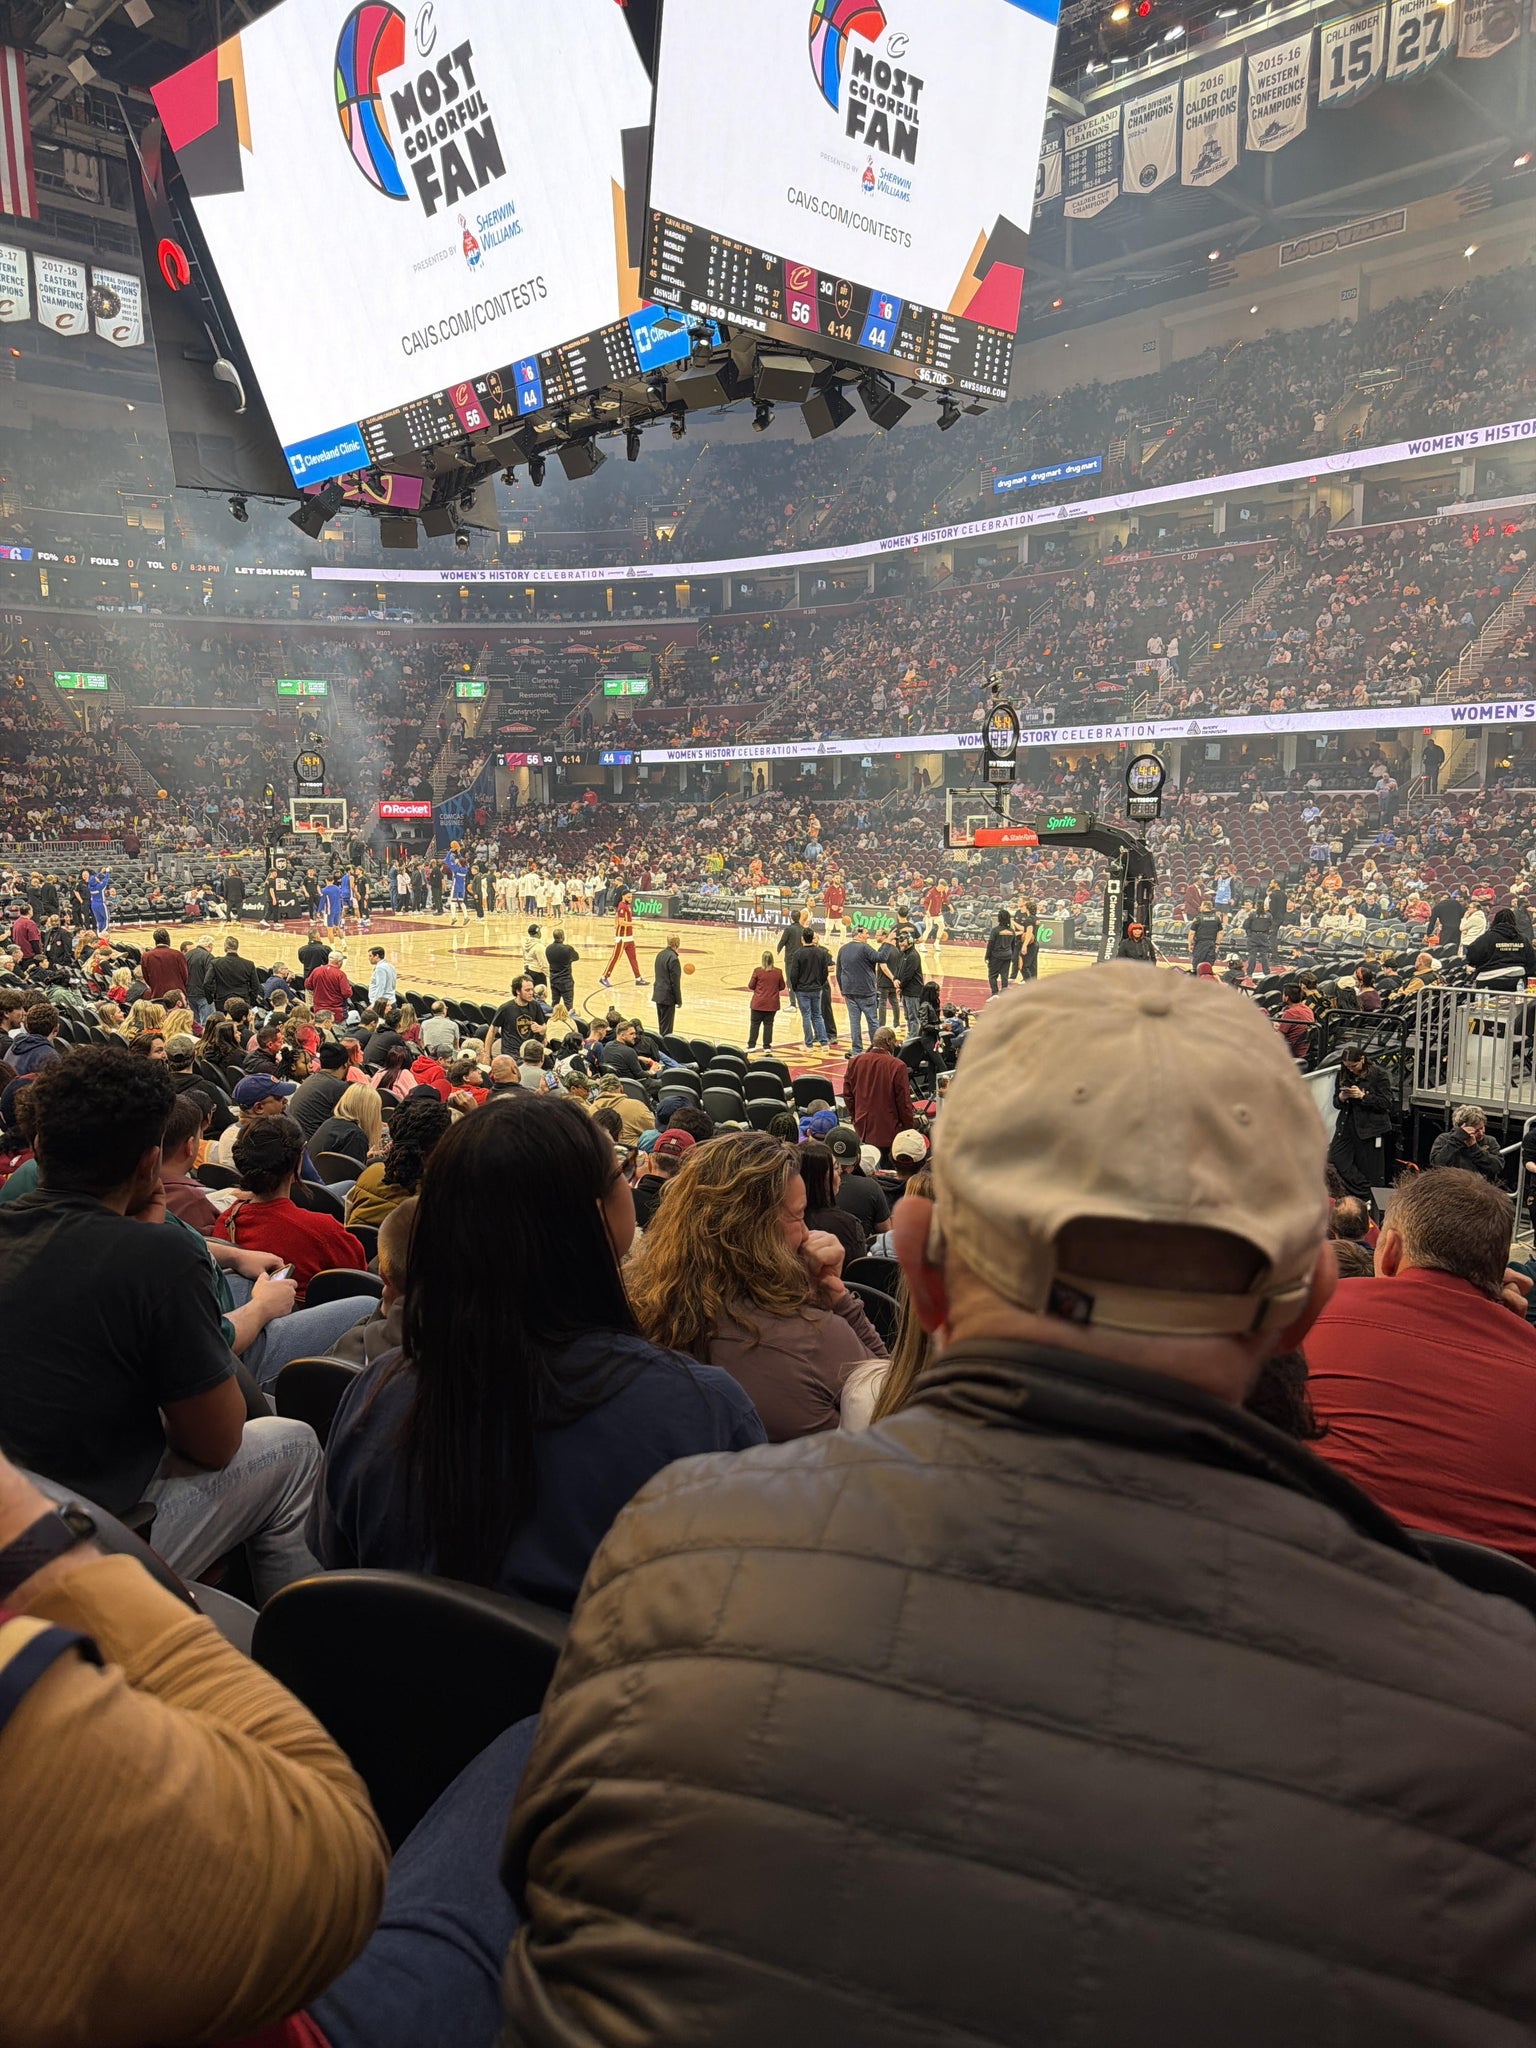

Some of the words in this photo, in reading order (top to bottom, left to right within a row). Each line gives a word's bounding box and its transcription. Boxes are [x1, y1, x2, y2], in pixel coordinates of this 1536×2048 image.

[1326, 15, 1380, 44] CALLANDER
[1394, 9, 1446, 68] 27
[1257, 47, 1301, 74] 2015-16
[1330, 33, 1373, 90] 15
[390, 39, 473, 134] MOST
[851, 46, 924, 106] MOST
[1200, 74, 1224, 93] 2016
[1258, 64, 1300, 90] WESTERN
[849, 79, 919, 125] COLORFUL
[1186, 93, 1218, 116] CALDER
[1220, 85, 1238, 104] CUP
[1250, 77, 1306, 107] CONFERENCE
[1128, 103, 1174, 130] CHAMPIONS
[1130, 105, 1147, 117] NORTH
[1148, 94, 1172, 110] DIVISION
[1186, 101, 1237, 131] CHAMPIONS
[1252, 93, 1303, 121] CHAMPIONS
[404, 89, 488, 160] COLORFUL
[845, 96, 919, 166] FAN
[1066, 110, 1118, 138] CLEVELAND
[1075, 123, 1110, 144] BARONS
[410, 115, 507, 218] FAN
[820, 152, 850, 171] PRESENTED
[878, 168, 912, 190] SHERWIN
[1072, 195, 1096, 209] CALDER
[1097, 190, 1110, 201] CUP
[477, 200, 516, 233] SHERWIN
[664, 217, 693, 234] CAVALIERS
[787, 187, 912, 248] CAVS.COM/CONTESTS
[42, 261, 78, 277] 2017-18
[413, 250, 448, 274] PRESENTED
[449, 245, 457, 257] BY
[44, 274, 77, 289] EASTERN
[117, 278, 140, 289] DIVISION
[661, 273, 686, 288] MITCHELL
[819, 281, 833, 295] 3Q
[39, 284, 84, 301] CONFERENCE
[41, 295, 84, 312] CHAMPIONS
[653, 287, 681, 303] oswald
[791, 301, 810, 324] 56
[837, 299, 848, 309] +12
[401, 275, 548, 356] CAVS.COM/CONTESTS
[727, 311, 766, 332] RAFFLE
[827, 320, 852, 340] 4:14
[868, 327, 886, 348] 44
[475, 381, 487, 394] 3Q
[919, 369, 947, 386] $6,705
[523, 389, 537, 407] 44
[465, 409, 481, 427] 56
[493, 403, 513, 421] 4:14
[304, 446, 341, 466] Cleveland
[339, 439, 361, 456] Clinic
[1408, 431, 1479, 455] WOMEN'S
[997, 480, 1012, 489] drug
[1011, 476, 1027, 484] mart
[1030, 473, 1046, 482] drug
[1045, 468, 1062, 477] mart
[1065, 465, 1081, 474] drug
[1081, 461, 1098, 470] mart
[879, 534, 919, 550] WOMEN'S
[921, 526, 959, 543] HISTORY
[961, 514, 1034, 535] CELEBRATION
[37, 551, 59, 562] FG%
[63, 554, 77, 564] 43
[90, 557, 120, 567] FOULS
[147, 560, 164, 570] TOL
[190, 563, 207, 572] 8:24
[208, 565, 220, 573] PM
[235, 566, 255, 575] LET
[256, 567, 271, 575] EM
[271, 568, 307, 576] KNOW.
[440, 571, 487, 581] WOMEN'S
[489, 571, 530, 581] HISTORY
[533, 569, 605, 580] CELEBRATION
[1451, 704, 1535, 721] WOMEN'S
[1062, 725, 1155, 741] CELEBRATION
[527, 754, 539, 764] 56
[562, 755, 581, 764] 4:14
[603, 754, 615, 764] 44
[667, 750, 703, 760] WOMEN'S
[705, 748, 737, 759] HISTORY
[738, 745, 798, 757] CELEBRATION
[393, 804, 429, 814] Rocket
[1047, 816, 1076, 830] Sprite
[632, 898, 662, 916] Sprite
[1108, 895, 1118, 936] Cleveland
[850, 910, 896, 932] Sprite
[1104, 937, 1115, 960] Clinic
